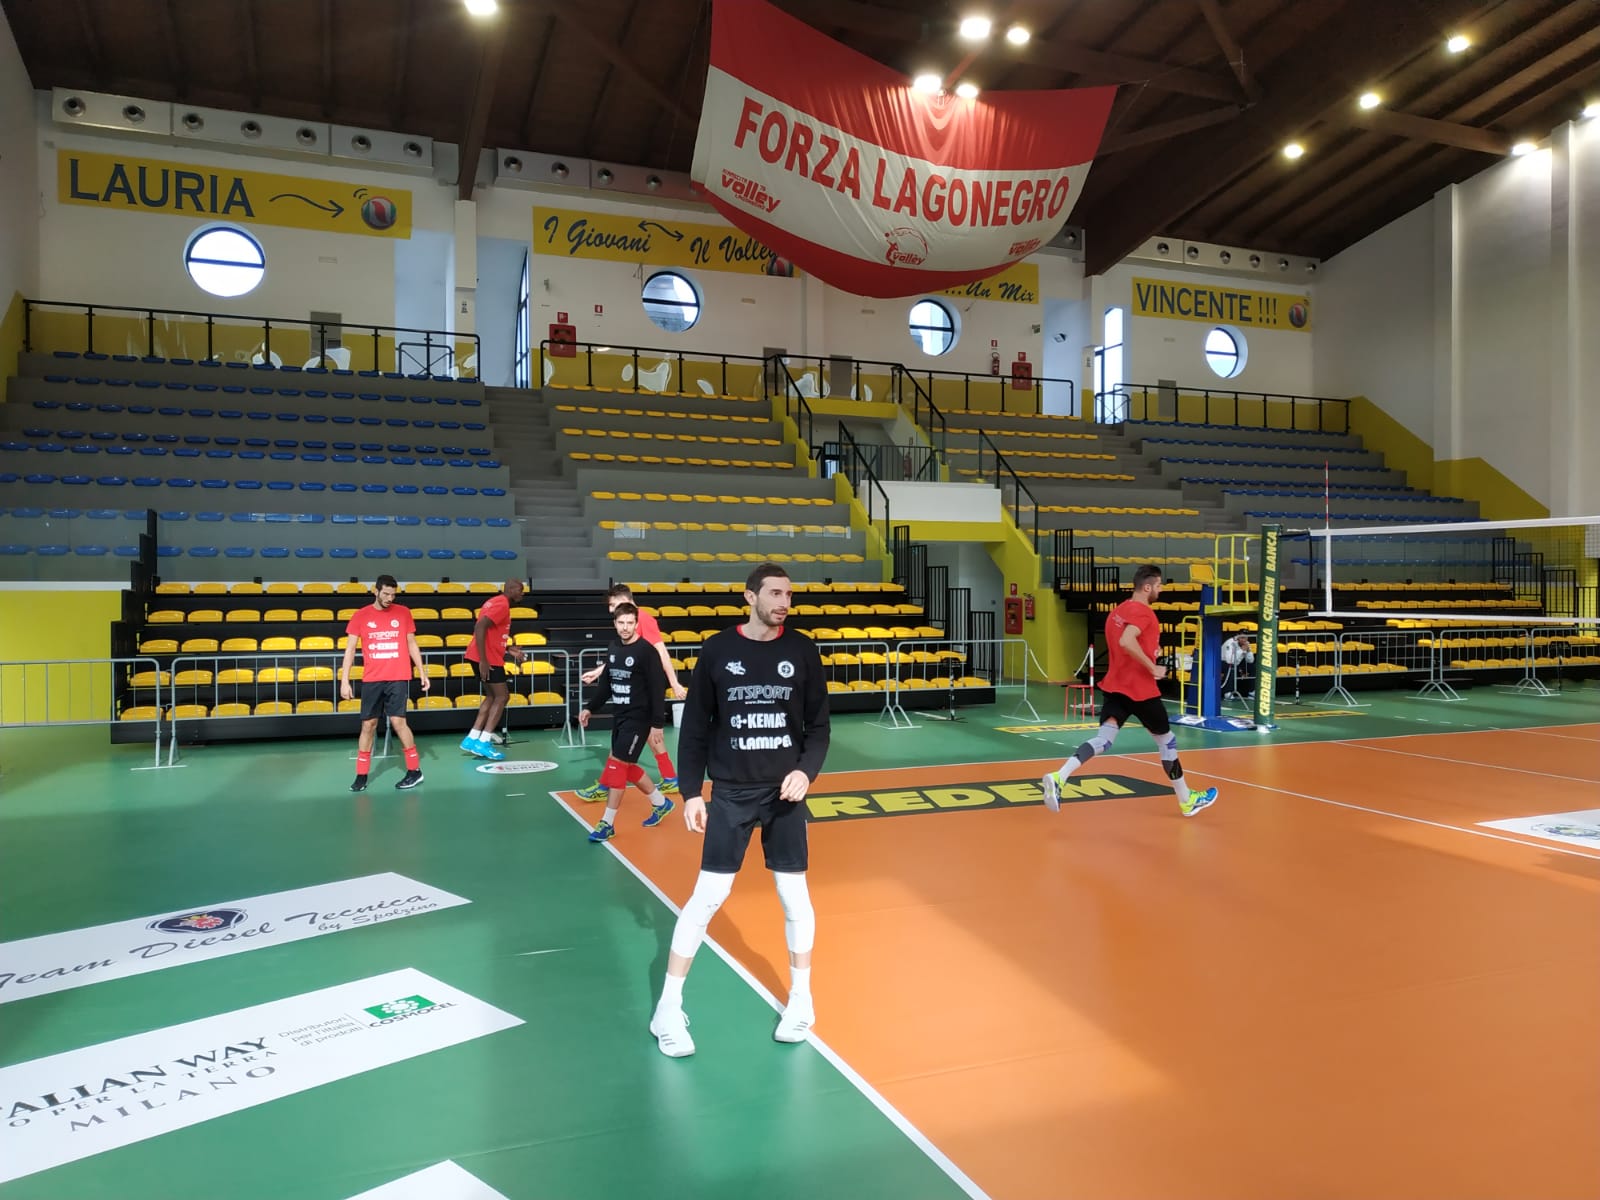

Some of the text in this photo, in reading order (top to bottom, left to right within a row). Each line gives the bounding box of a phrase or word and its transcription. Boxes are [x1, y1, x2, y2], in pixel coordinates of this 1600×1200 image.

[734, 96, 1070, 227] FORZA LAGONEGRO
[69, 158, 255, 217] LAURIA
[543, 215, 651, 254] I Giovani
[690, 236, 711, 265] Il
[998, 282, 1034, 302] Mix
[1259, 531, 1278, 717] CREDEM BANCA CREDEM BANCA
[727, 685, 793, 701] ZTSPORT
[747, 712, 787, 729] KEMAS
[805, 777, 1136, 818] REDEM
[0, 894, 430, 989] Team Diesel Tecnica
[318, 921, 343, 932] by
[277, 1016, 348, 1038] Distributori
[368, 1002, 459, 1028] COSMOCEL
[291, 1033, 313, 1043] per
[300, 1026, 364, 1047] di prodotti
[0, 1036, 268, 1119] ALIAN WAY
[51, 1095, 113, 1116] PER
[130, 1081, 168, 1094] LA
[181, 1050, 278, 1078] TERRA
[70, 1066, 276, 1132] MILANO
